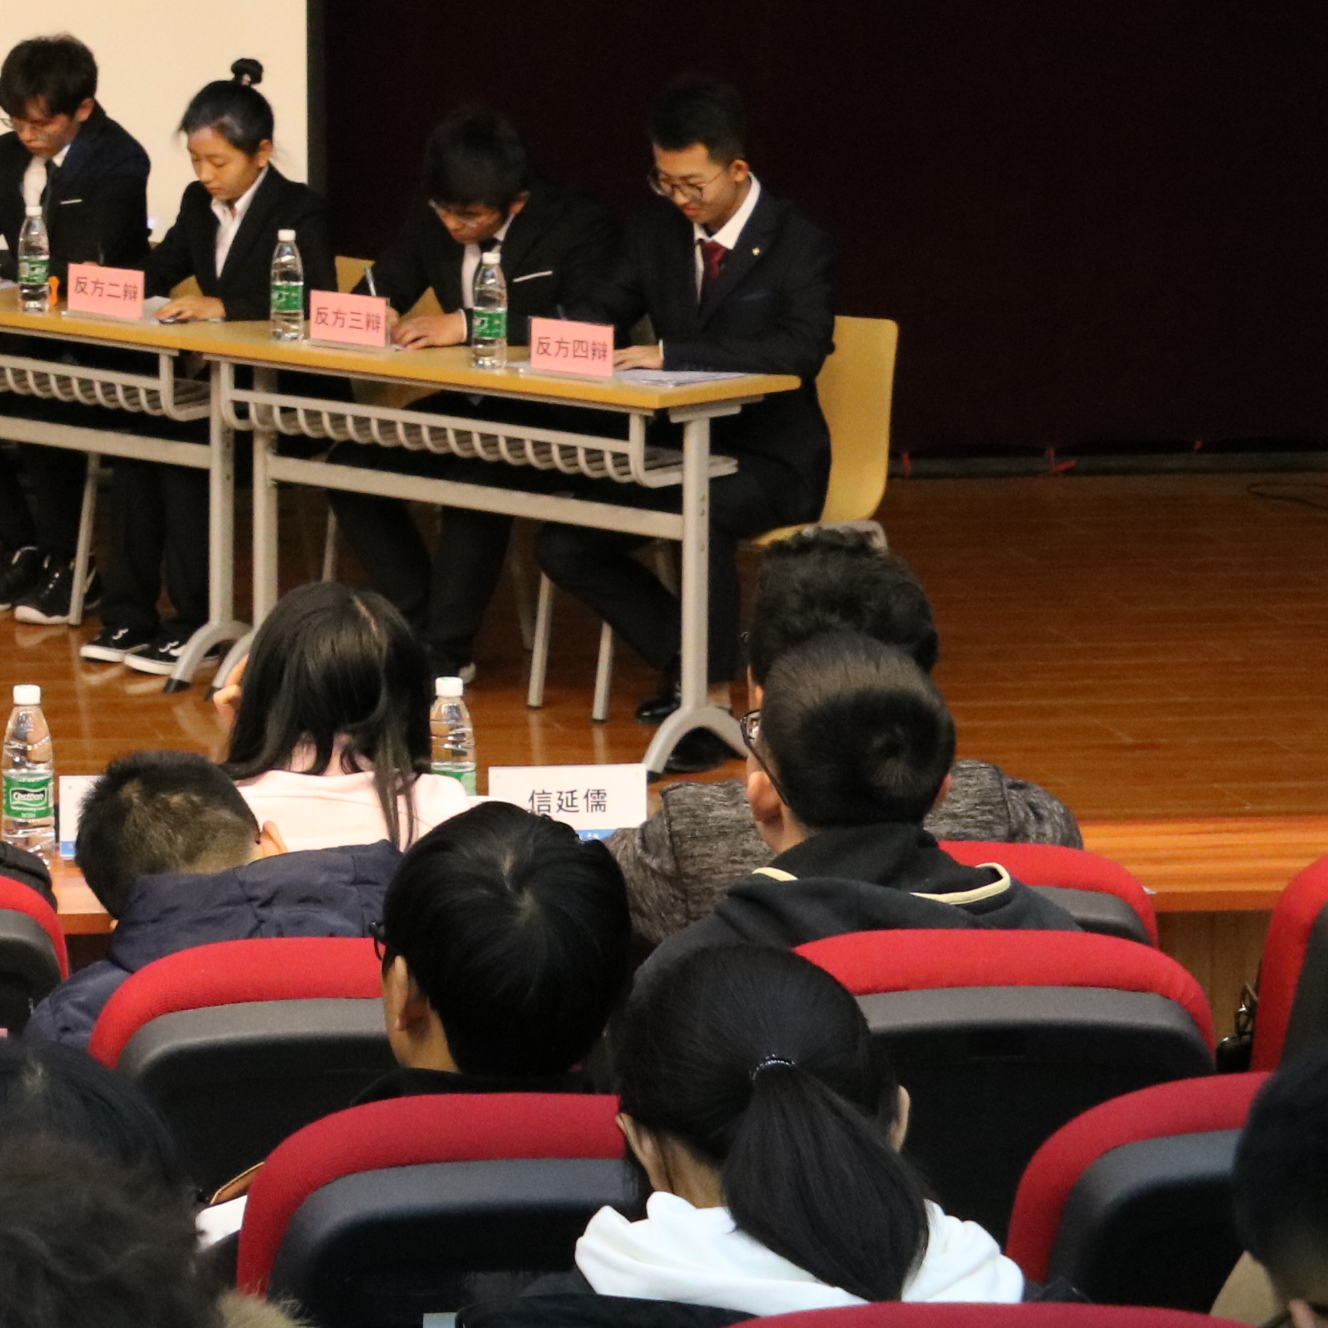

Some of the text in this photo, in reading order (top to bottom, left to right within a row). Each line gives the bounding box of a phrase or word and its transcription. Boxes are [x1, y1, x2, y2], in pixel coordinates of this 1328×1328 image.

[73, 275, 139, 302] 反方二辩
[313, 305, 382, 333] 反方三辩
[535, 335, 609, 363] 反方四辩
[528, 788, 607, 814] 信延儒
